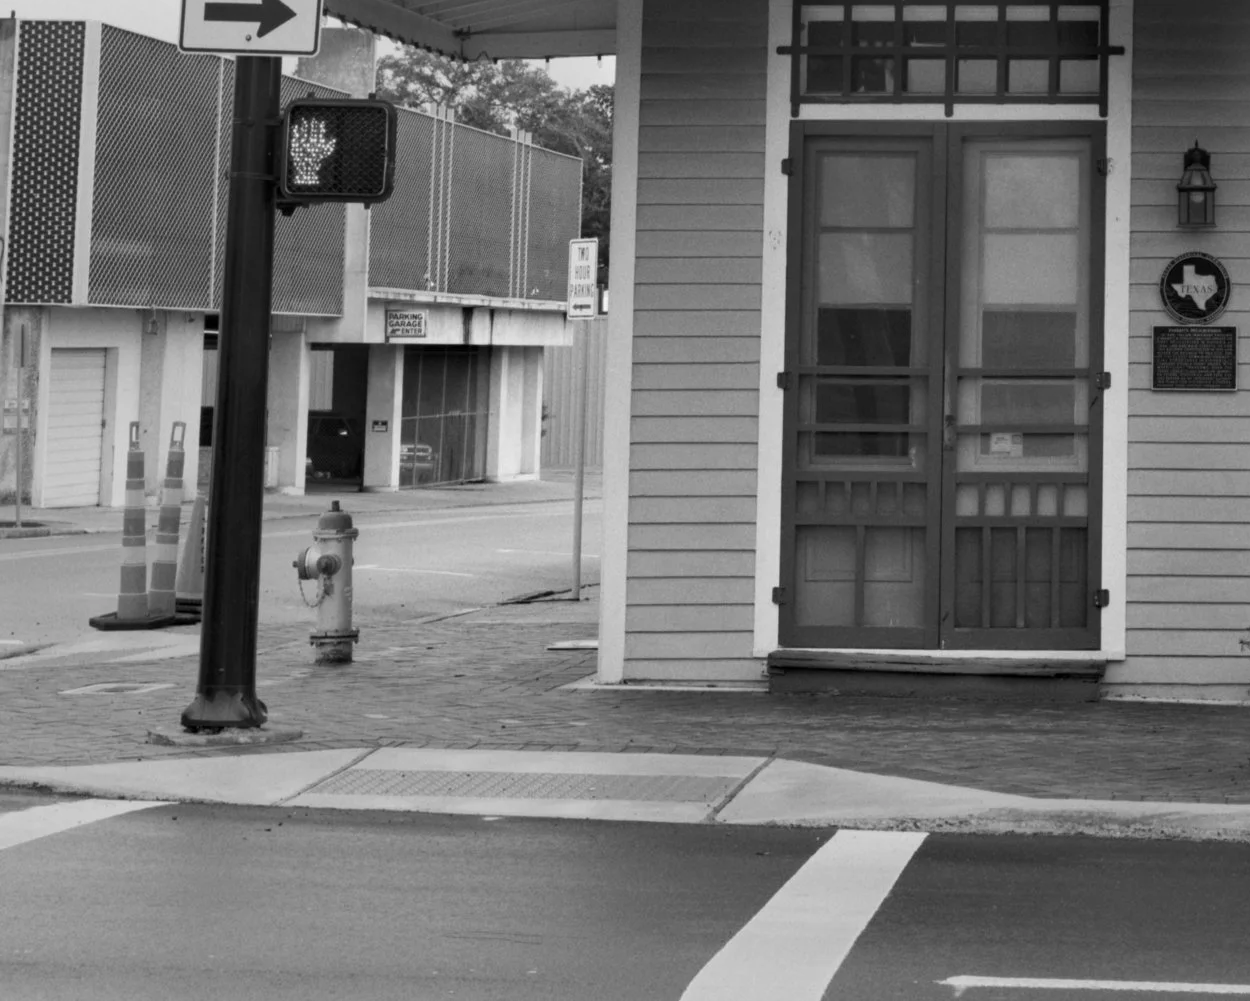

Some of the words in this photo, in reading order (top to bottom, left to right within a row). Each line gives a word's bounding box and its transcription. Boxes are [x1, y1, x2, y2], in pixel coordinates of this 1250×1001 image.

[578, 247, 589, 261] TWO
[575, 265, 591, 280] HOUR
[570, 283, 594, 298] PARKING
[1180, 284, 1213, 294] TEXAS
